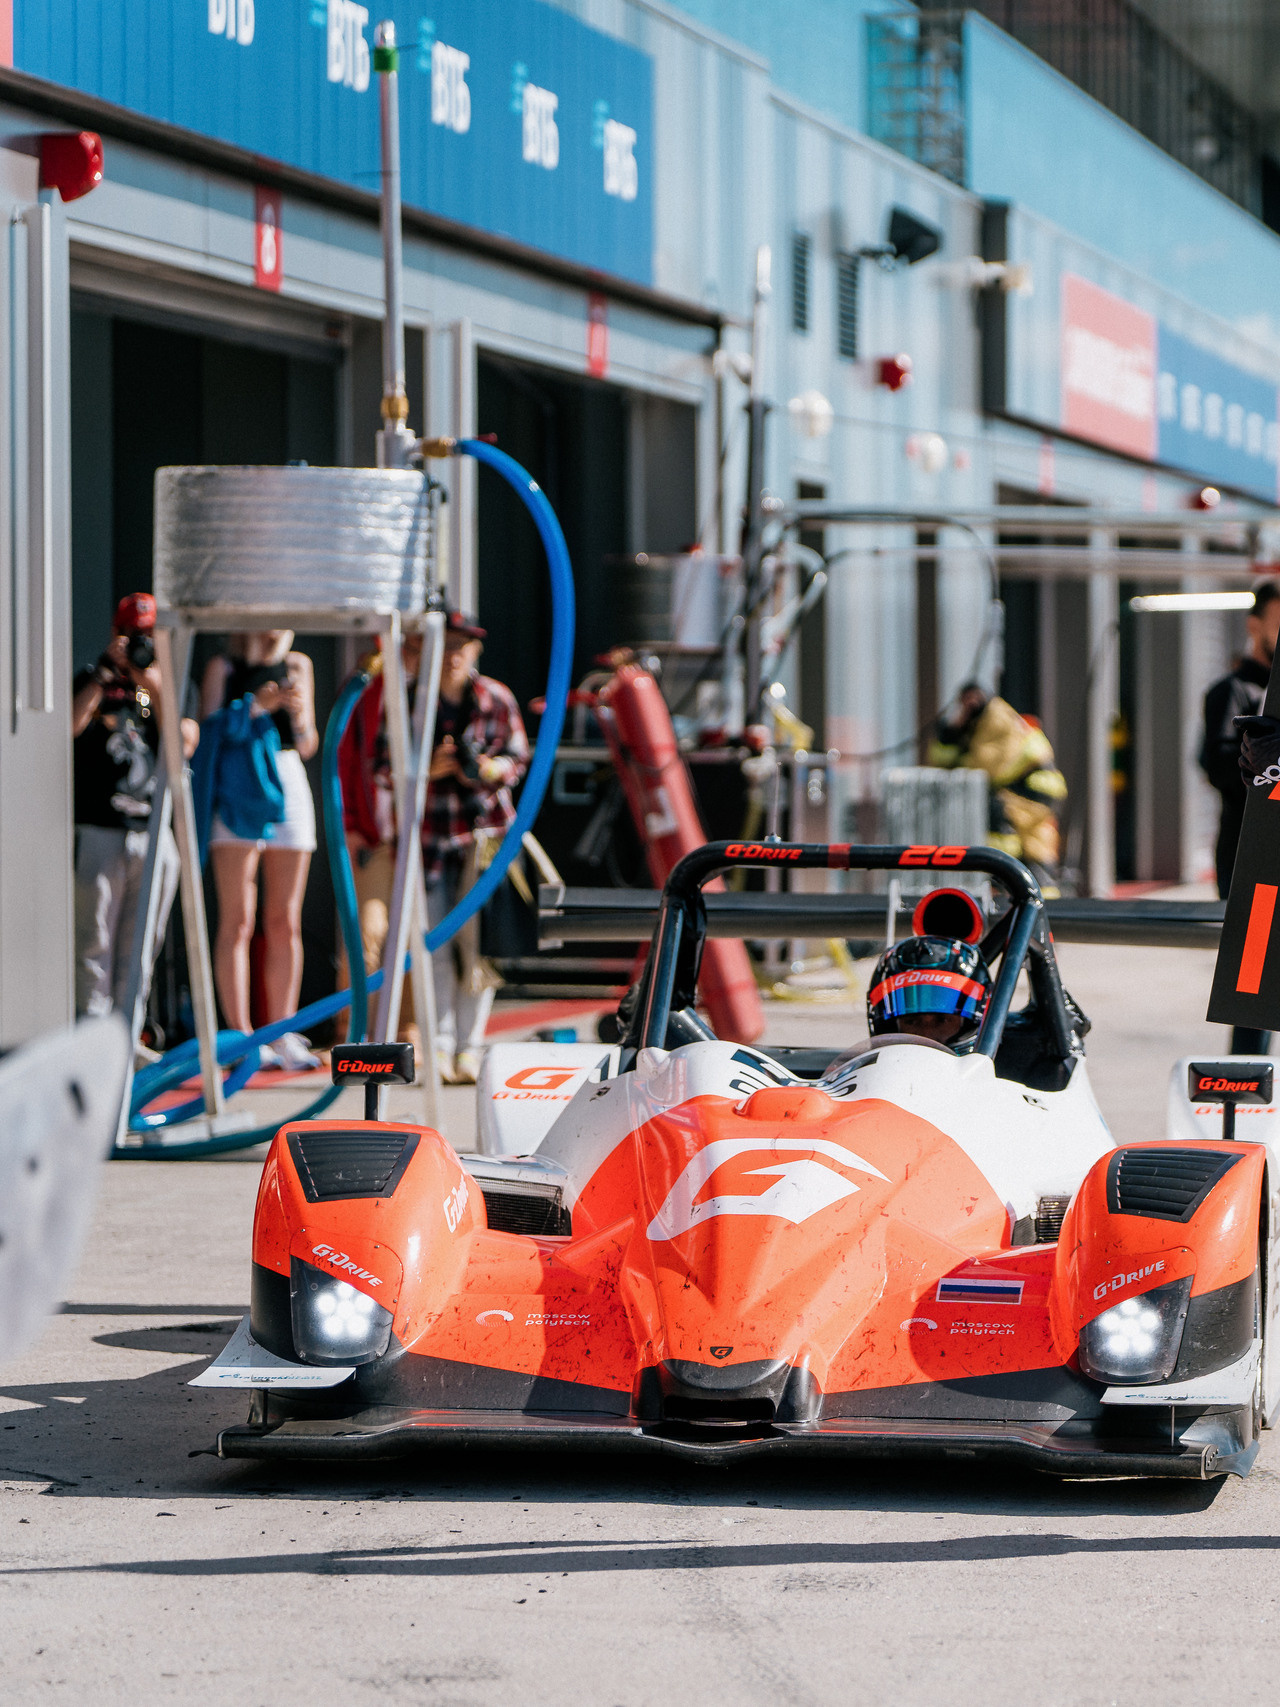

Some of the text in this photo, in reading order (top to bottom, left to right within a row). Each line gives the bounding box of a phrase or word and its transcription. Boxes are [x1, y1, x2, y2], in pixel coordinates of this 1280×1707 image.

[899, 845, 970, 866] 26
[525, 1319, 591, 1327] polytech
[951, 1321, 1015, 1329] moscow
[949, 1328, 1015, 1336] polytech
